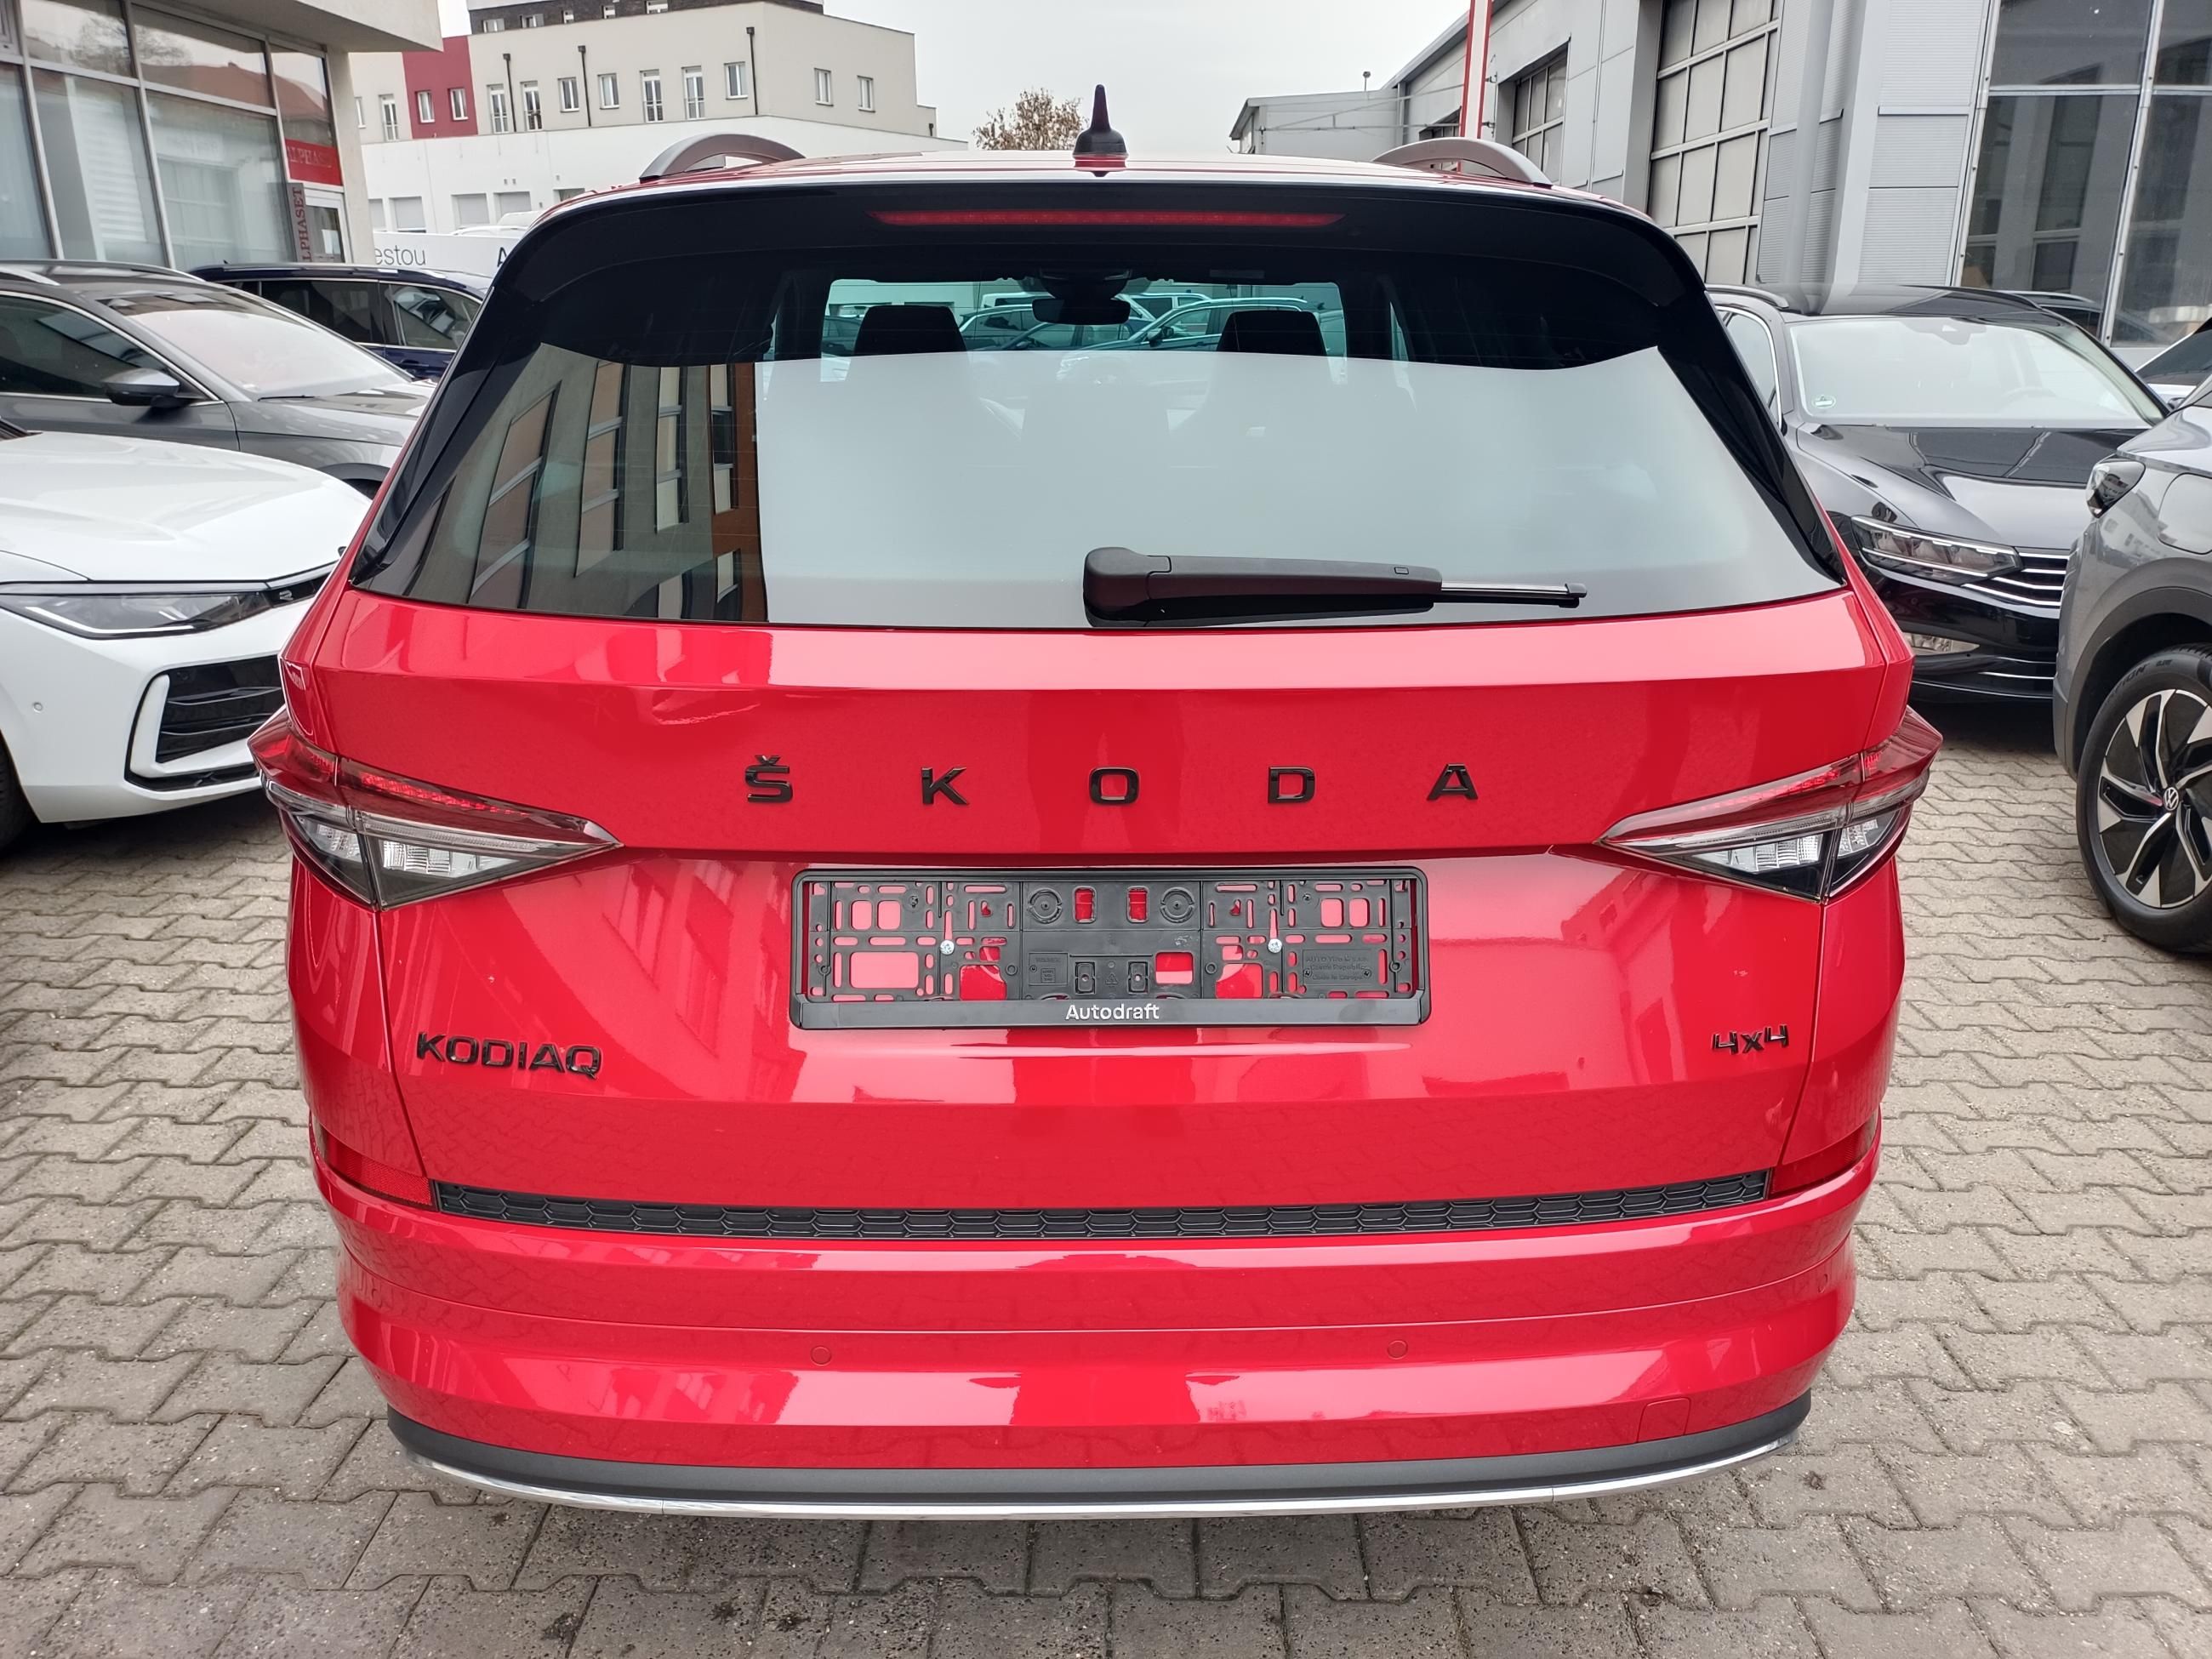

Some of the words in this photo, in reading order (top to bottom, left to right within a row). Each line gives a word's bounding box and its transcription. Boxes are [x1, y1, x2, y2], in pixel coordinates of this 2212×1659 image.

[292, 187, 312, 262] LPHASET
[744, 755, 1479, 804] ŠKODA
[1065, 1003, 1160, 1021] Autodraft
[416, 1032, 602, 1080] KODIAQ
[1712, 1024, 1790, 1055] 4x4
